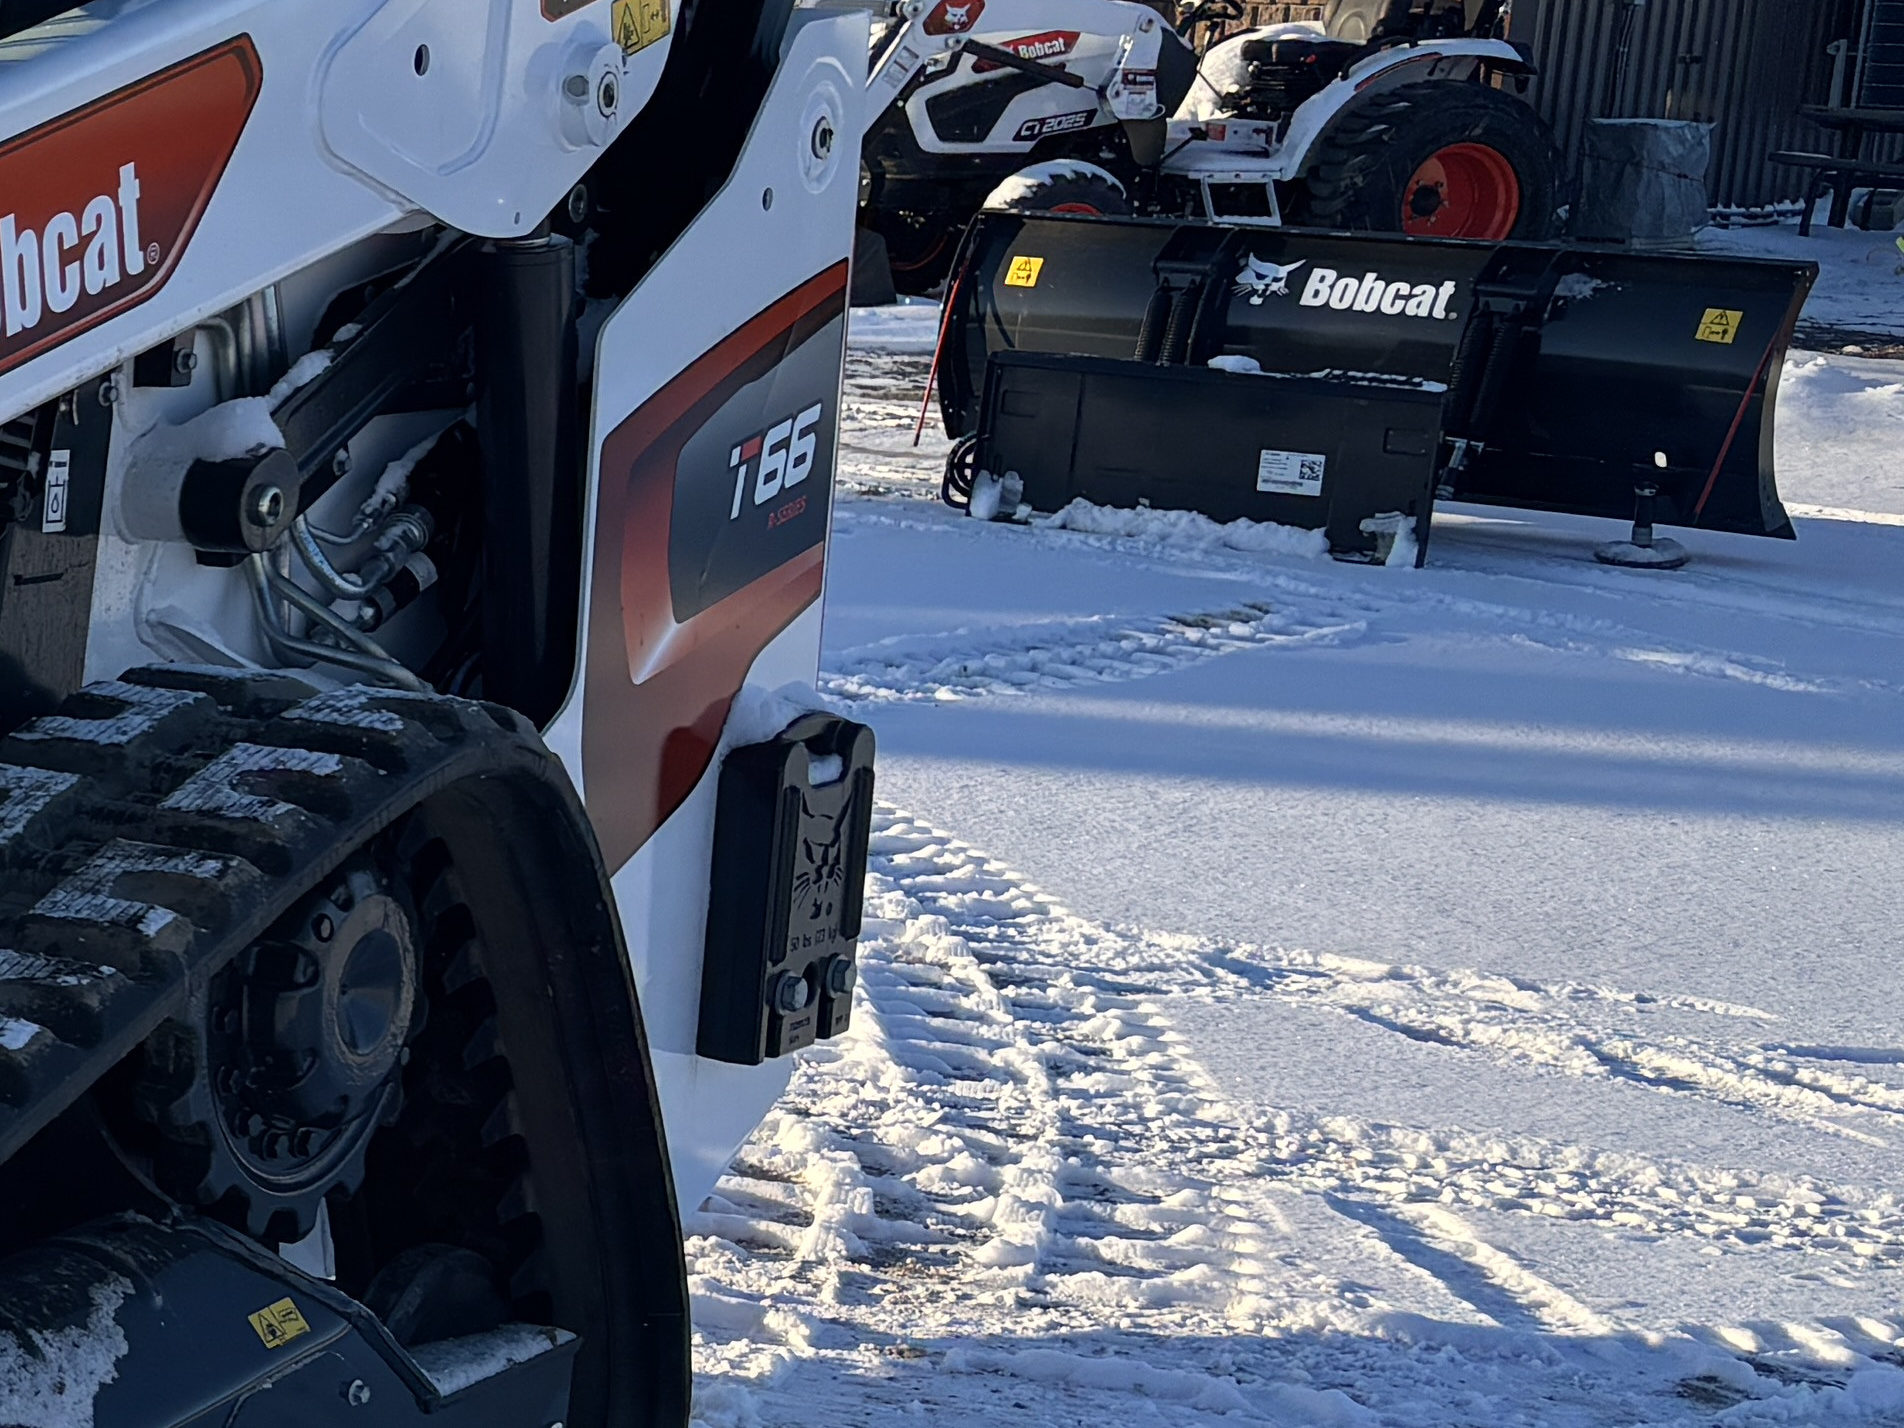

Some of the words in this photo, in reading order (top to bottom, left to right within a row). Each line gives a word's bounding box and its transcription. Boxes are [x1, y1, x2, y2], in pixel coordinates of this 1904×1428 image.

[1018, 36, 1065, 60] Bobcat
[1299, 268, 1456, 320] Bobcat
[729, 402, 822, 520] T66
